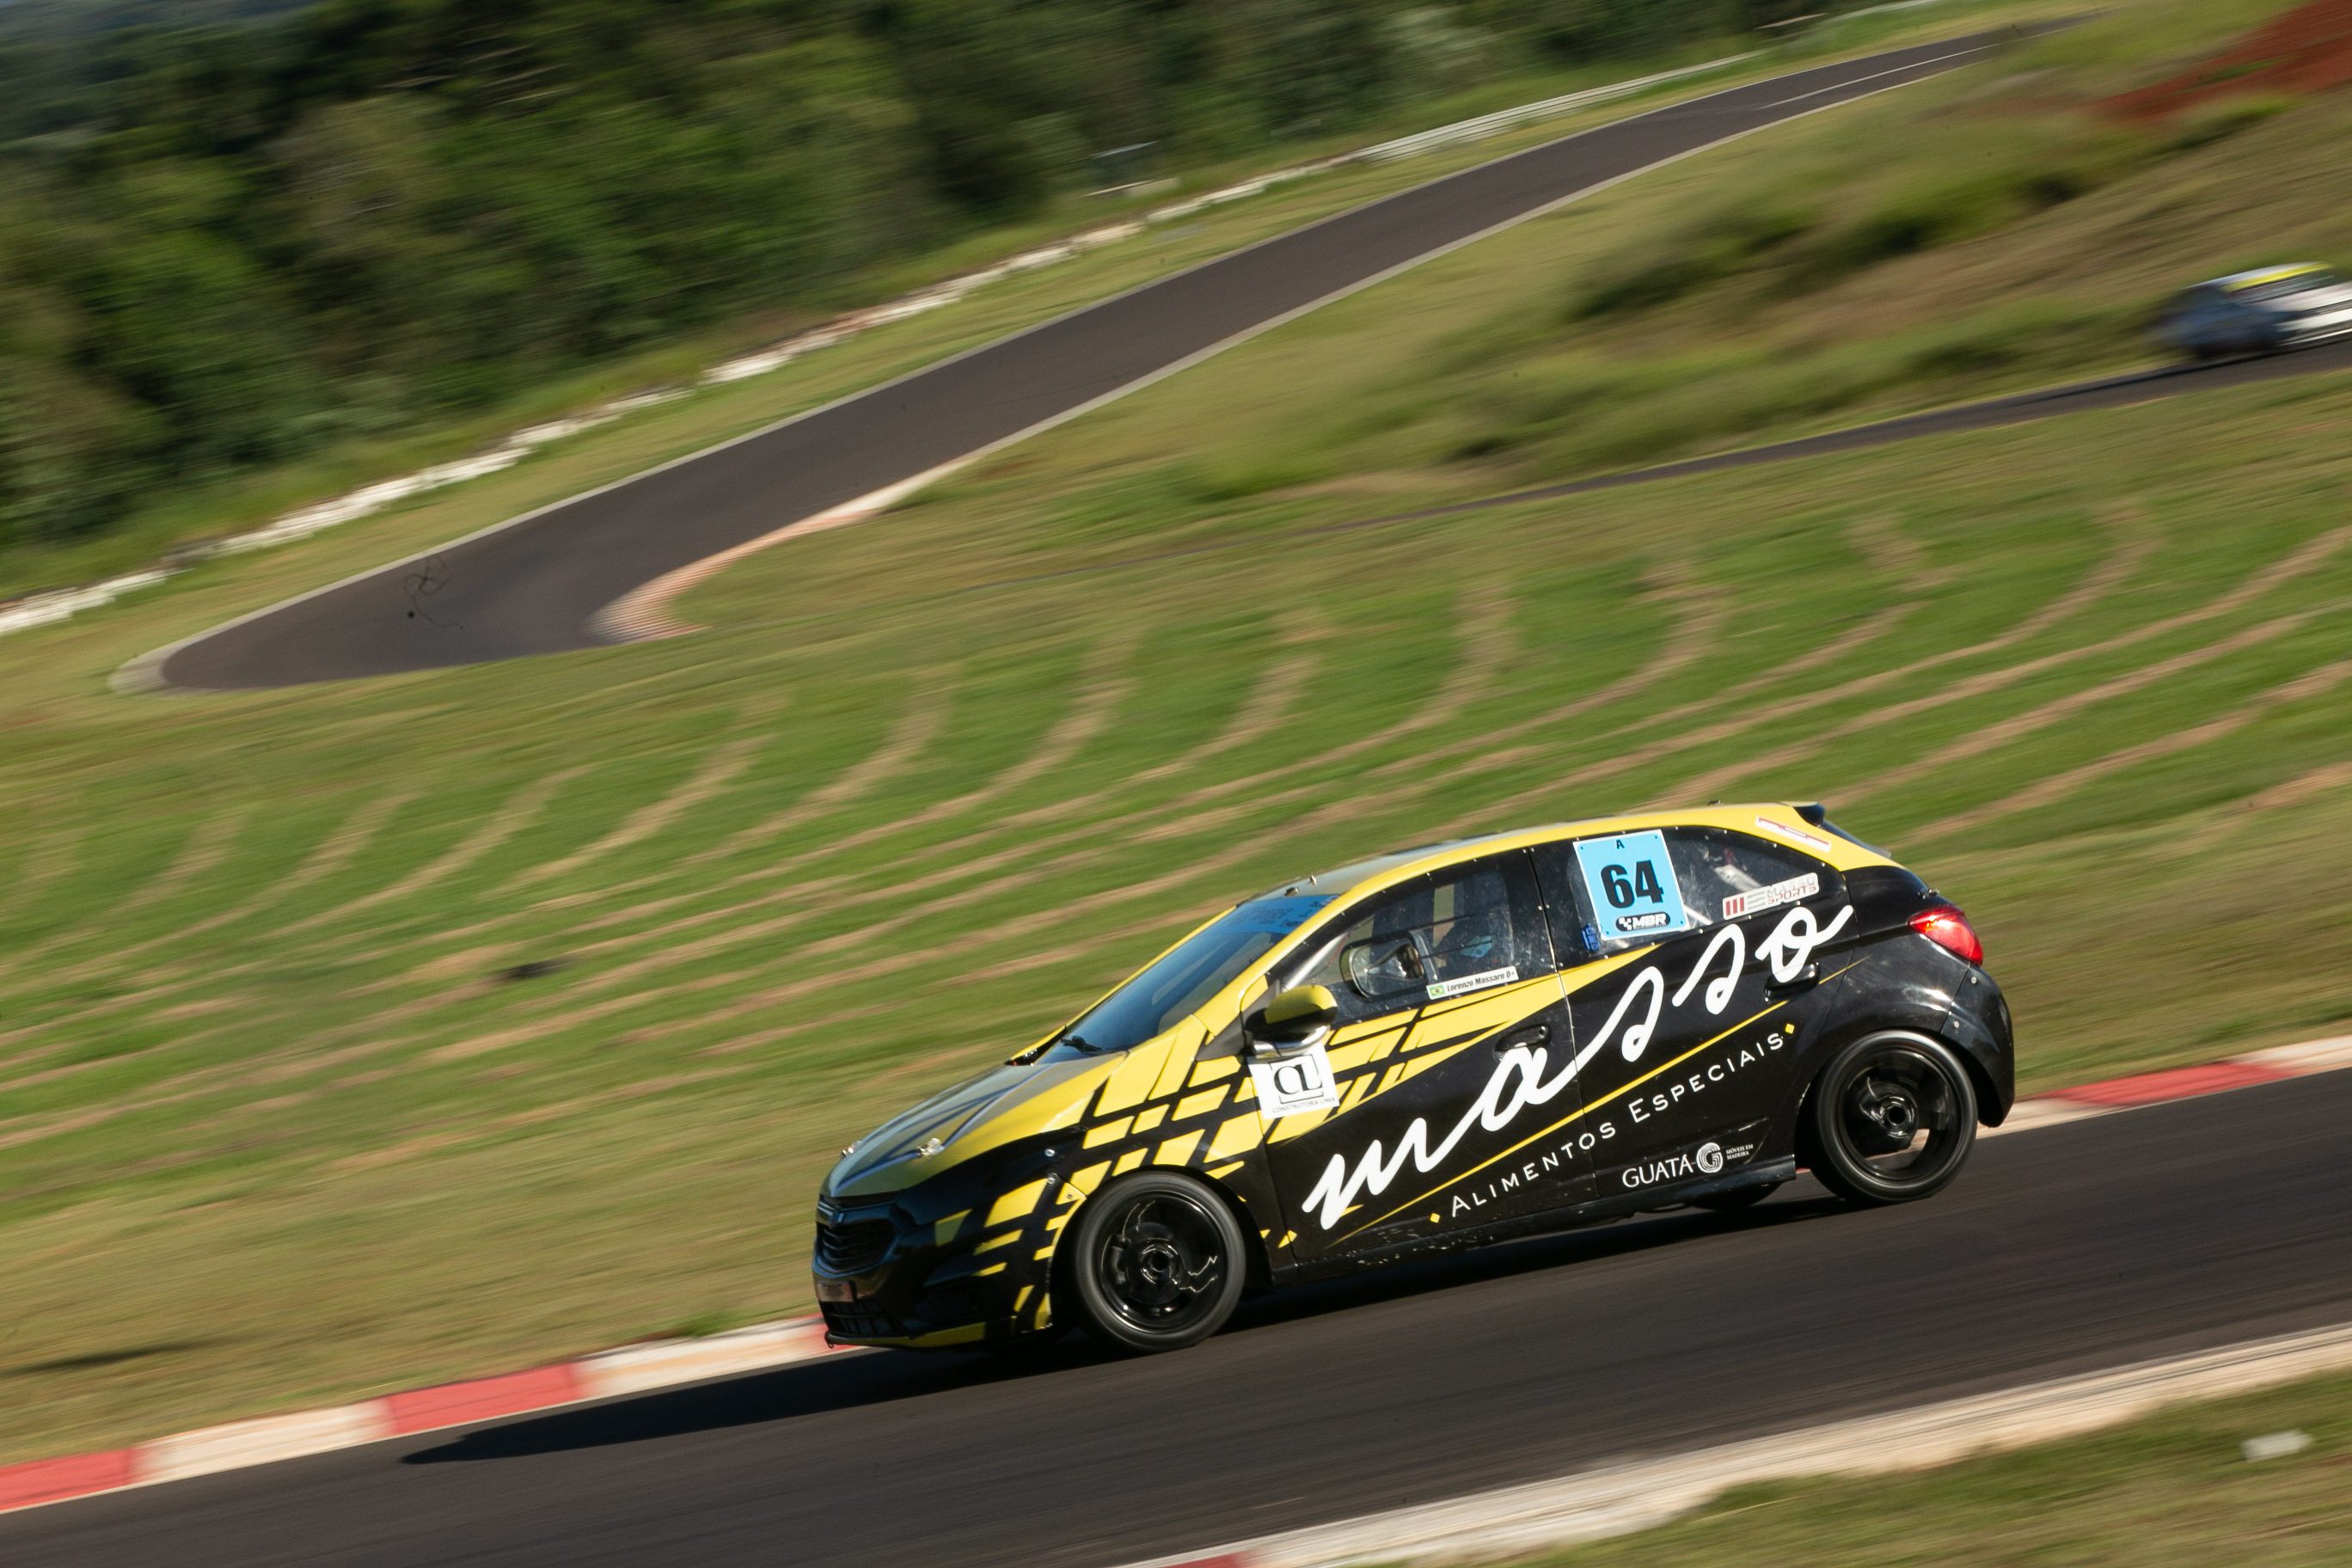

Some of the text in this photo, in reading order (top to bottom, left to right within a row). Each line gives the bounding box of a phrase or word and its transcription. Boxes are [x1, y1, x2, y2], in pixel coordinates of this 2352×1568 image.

[1616, 839, 1625, 849] A
[1600, 860, 1663, 909] 64
[1767, 883, 1816, 905] SPORTS
[1632, 913, 1666, 928] MBR
[1447, 981, 1473, 992] Lorenzo
[1475, 971, 1504, 985] Massaro
[1622, 1154, 1694, 1188] GUATÁ
